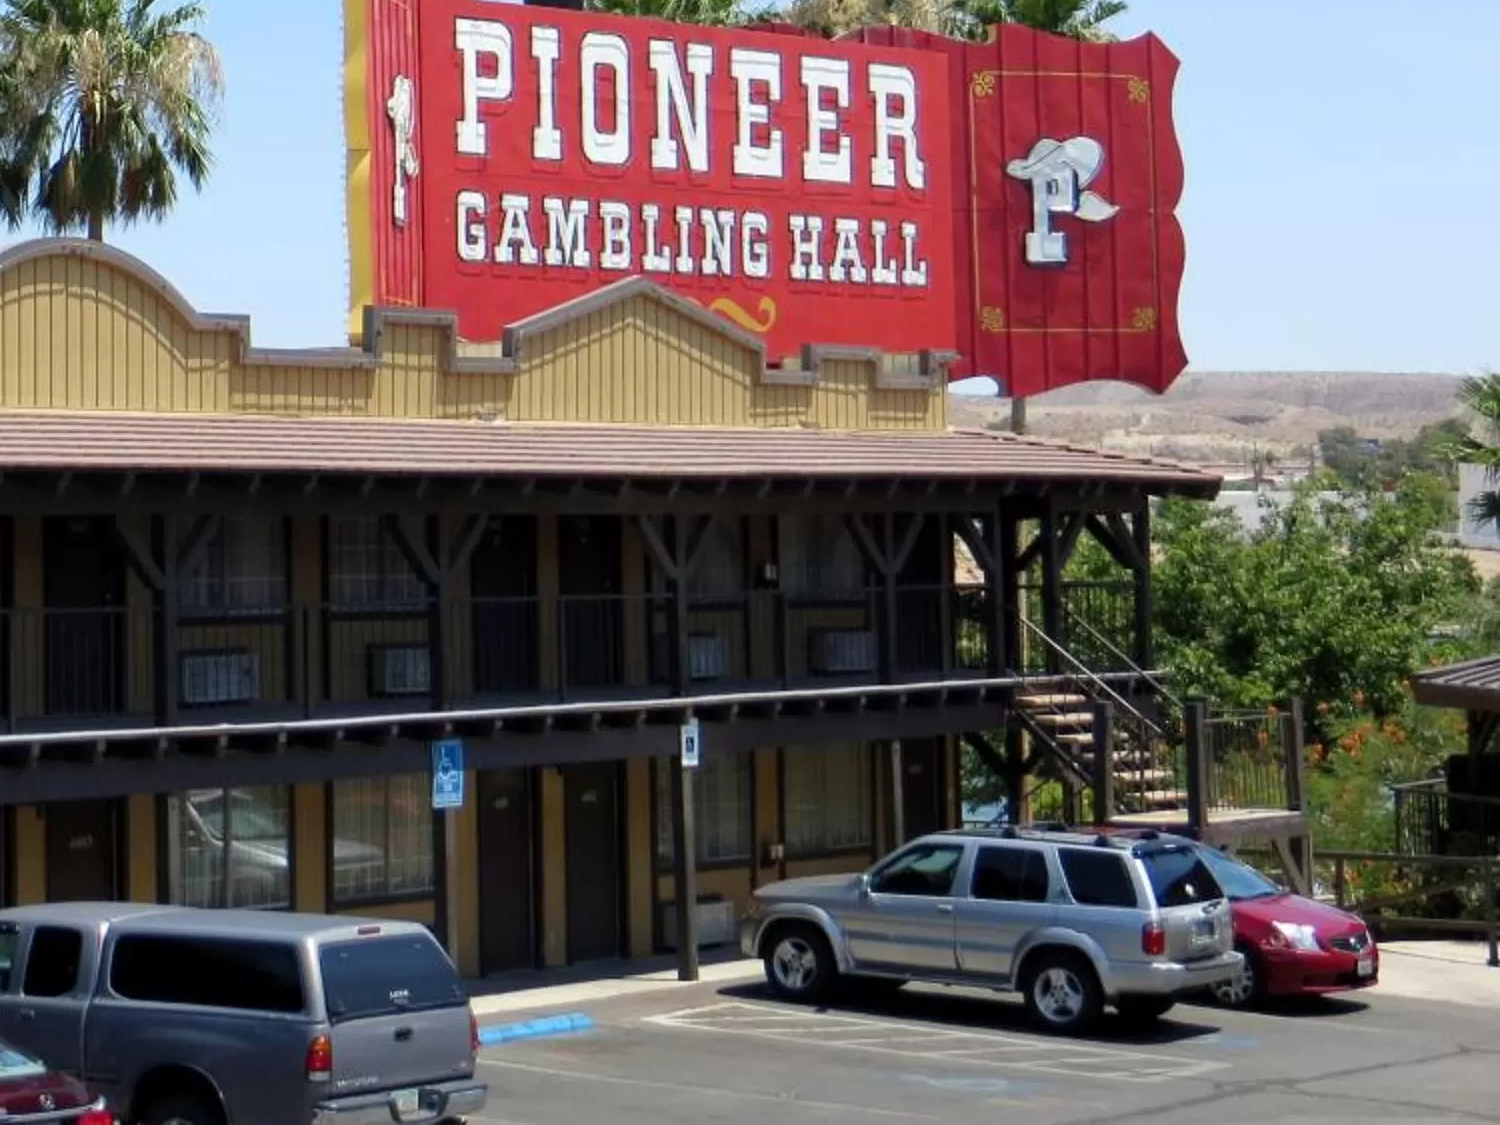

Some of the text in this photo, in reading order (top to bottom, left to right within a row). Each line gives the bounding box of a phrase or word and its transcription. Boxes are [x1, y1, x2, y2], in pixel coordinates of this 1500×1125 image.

[454, 17, 926, 190] PIONEER
[456, 190, 928, 287] GAMBLING HALL
